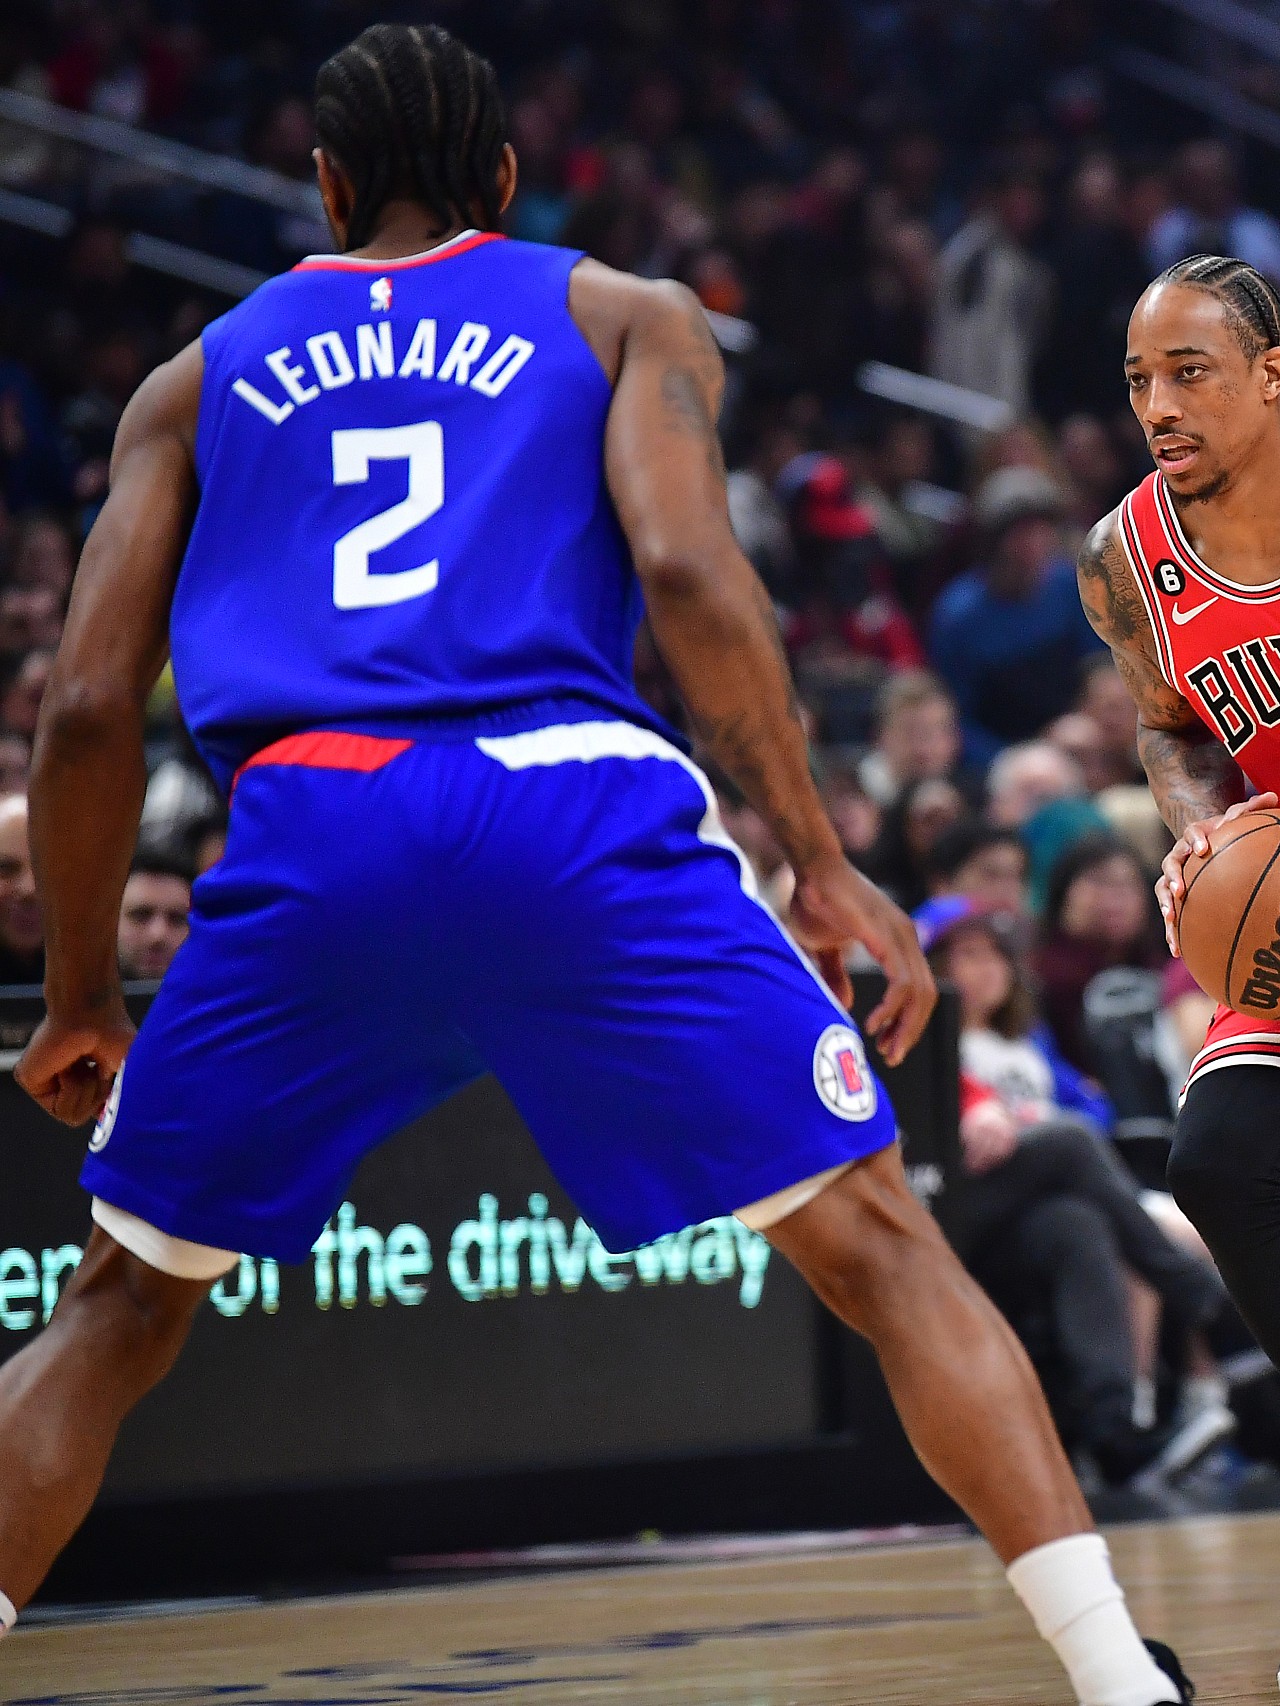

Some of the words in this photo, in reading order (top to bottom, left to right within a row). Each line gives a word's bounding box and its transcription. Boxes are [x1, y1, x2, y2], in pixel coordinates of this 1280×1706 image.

[232, 318, 536, 426] LEONARD
[331, 419, 445, 611] 2
[1160, 563, 1181, 592] 6
[310, 1201, 434, 1311] the
[447, 1192, 771, 1309] driveway
